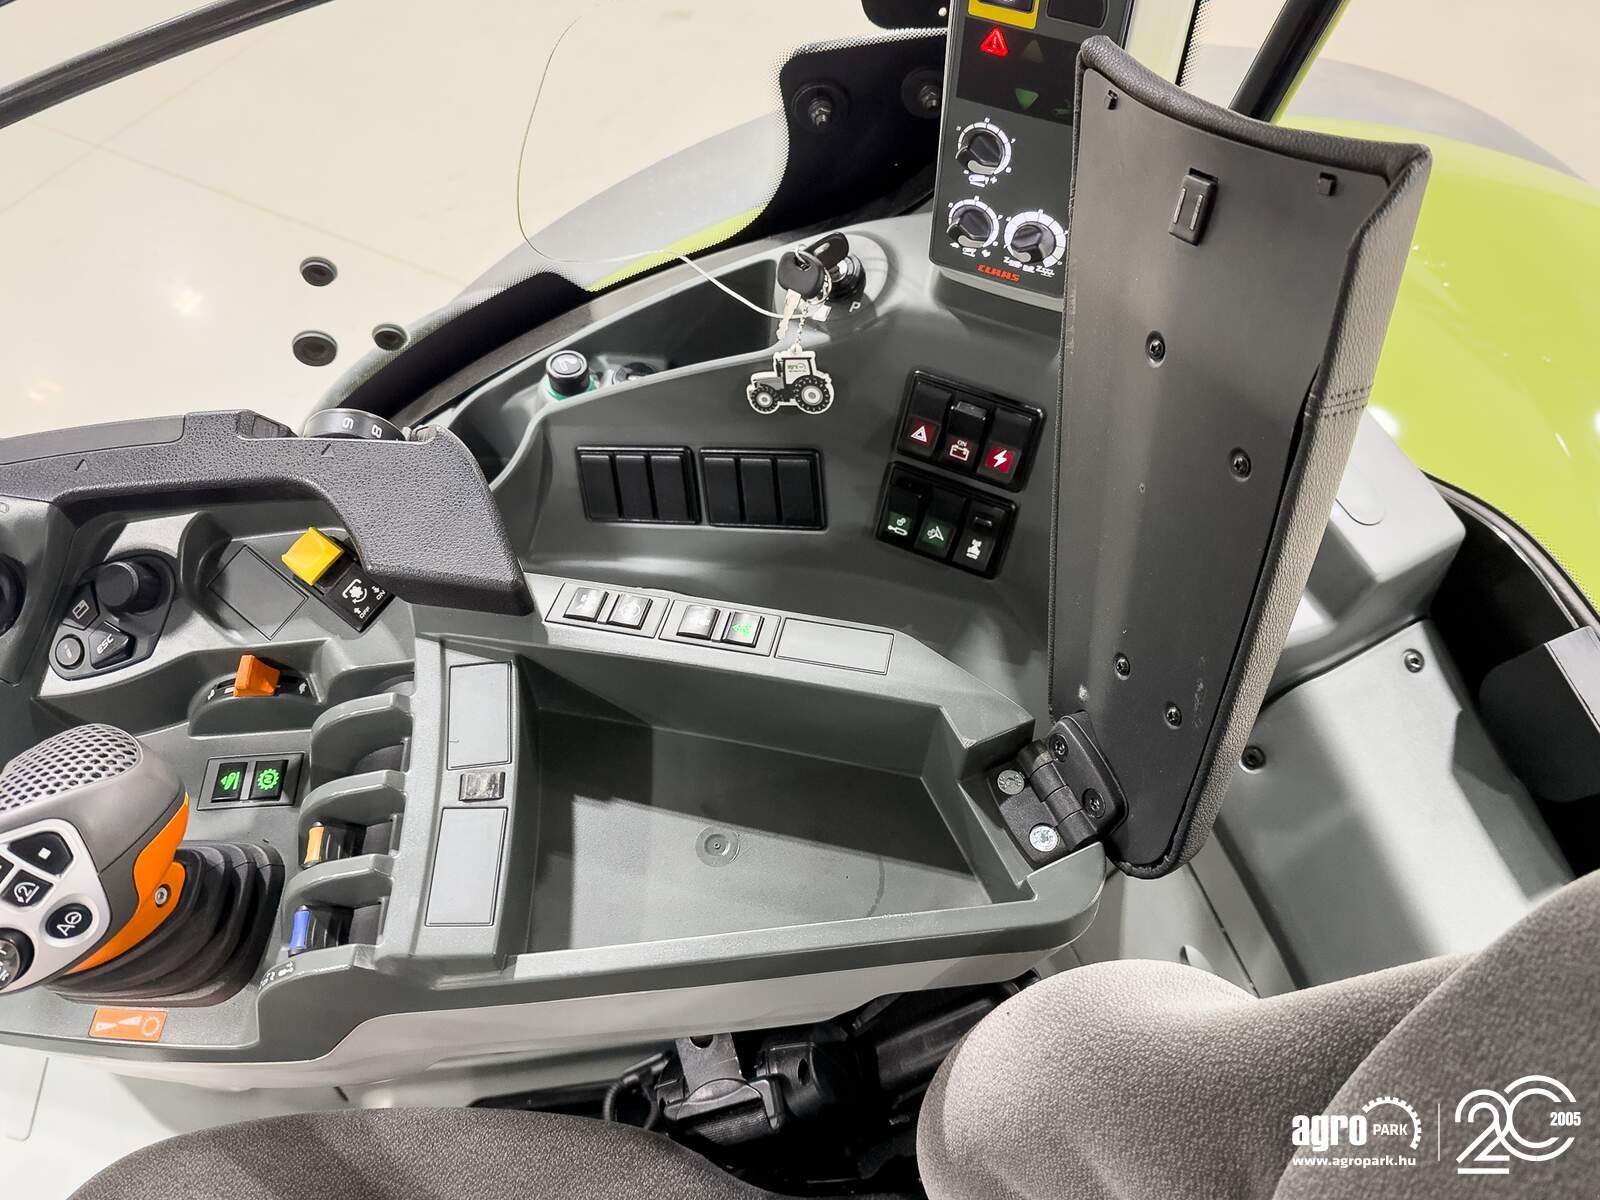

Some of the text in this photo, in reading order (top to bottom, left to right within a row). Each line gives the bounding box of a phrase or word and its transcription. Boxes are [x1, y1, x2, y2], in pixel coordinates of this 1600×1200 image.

[977, 264, 1019, 281] CLAAS
[848, 301, 861, 312] P
[371, 424, 382, 438] 8
